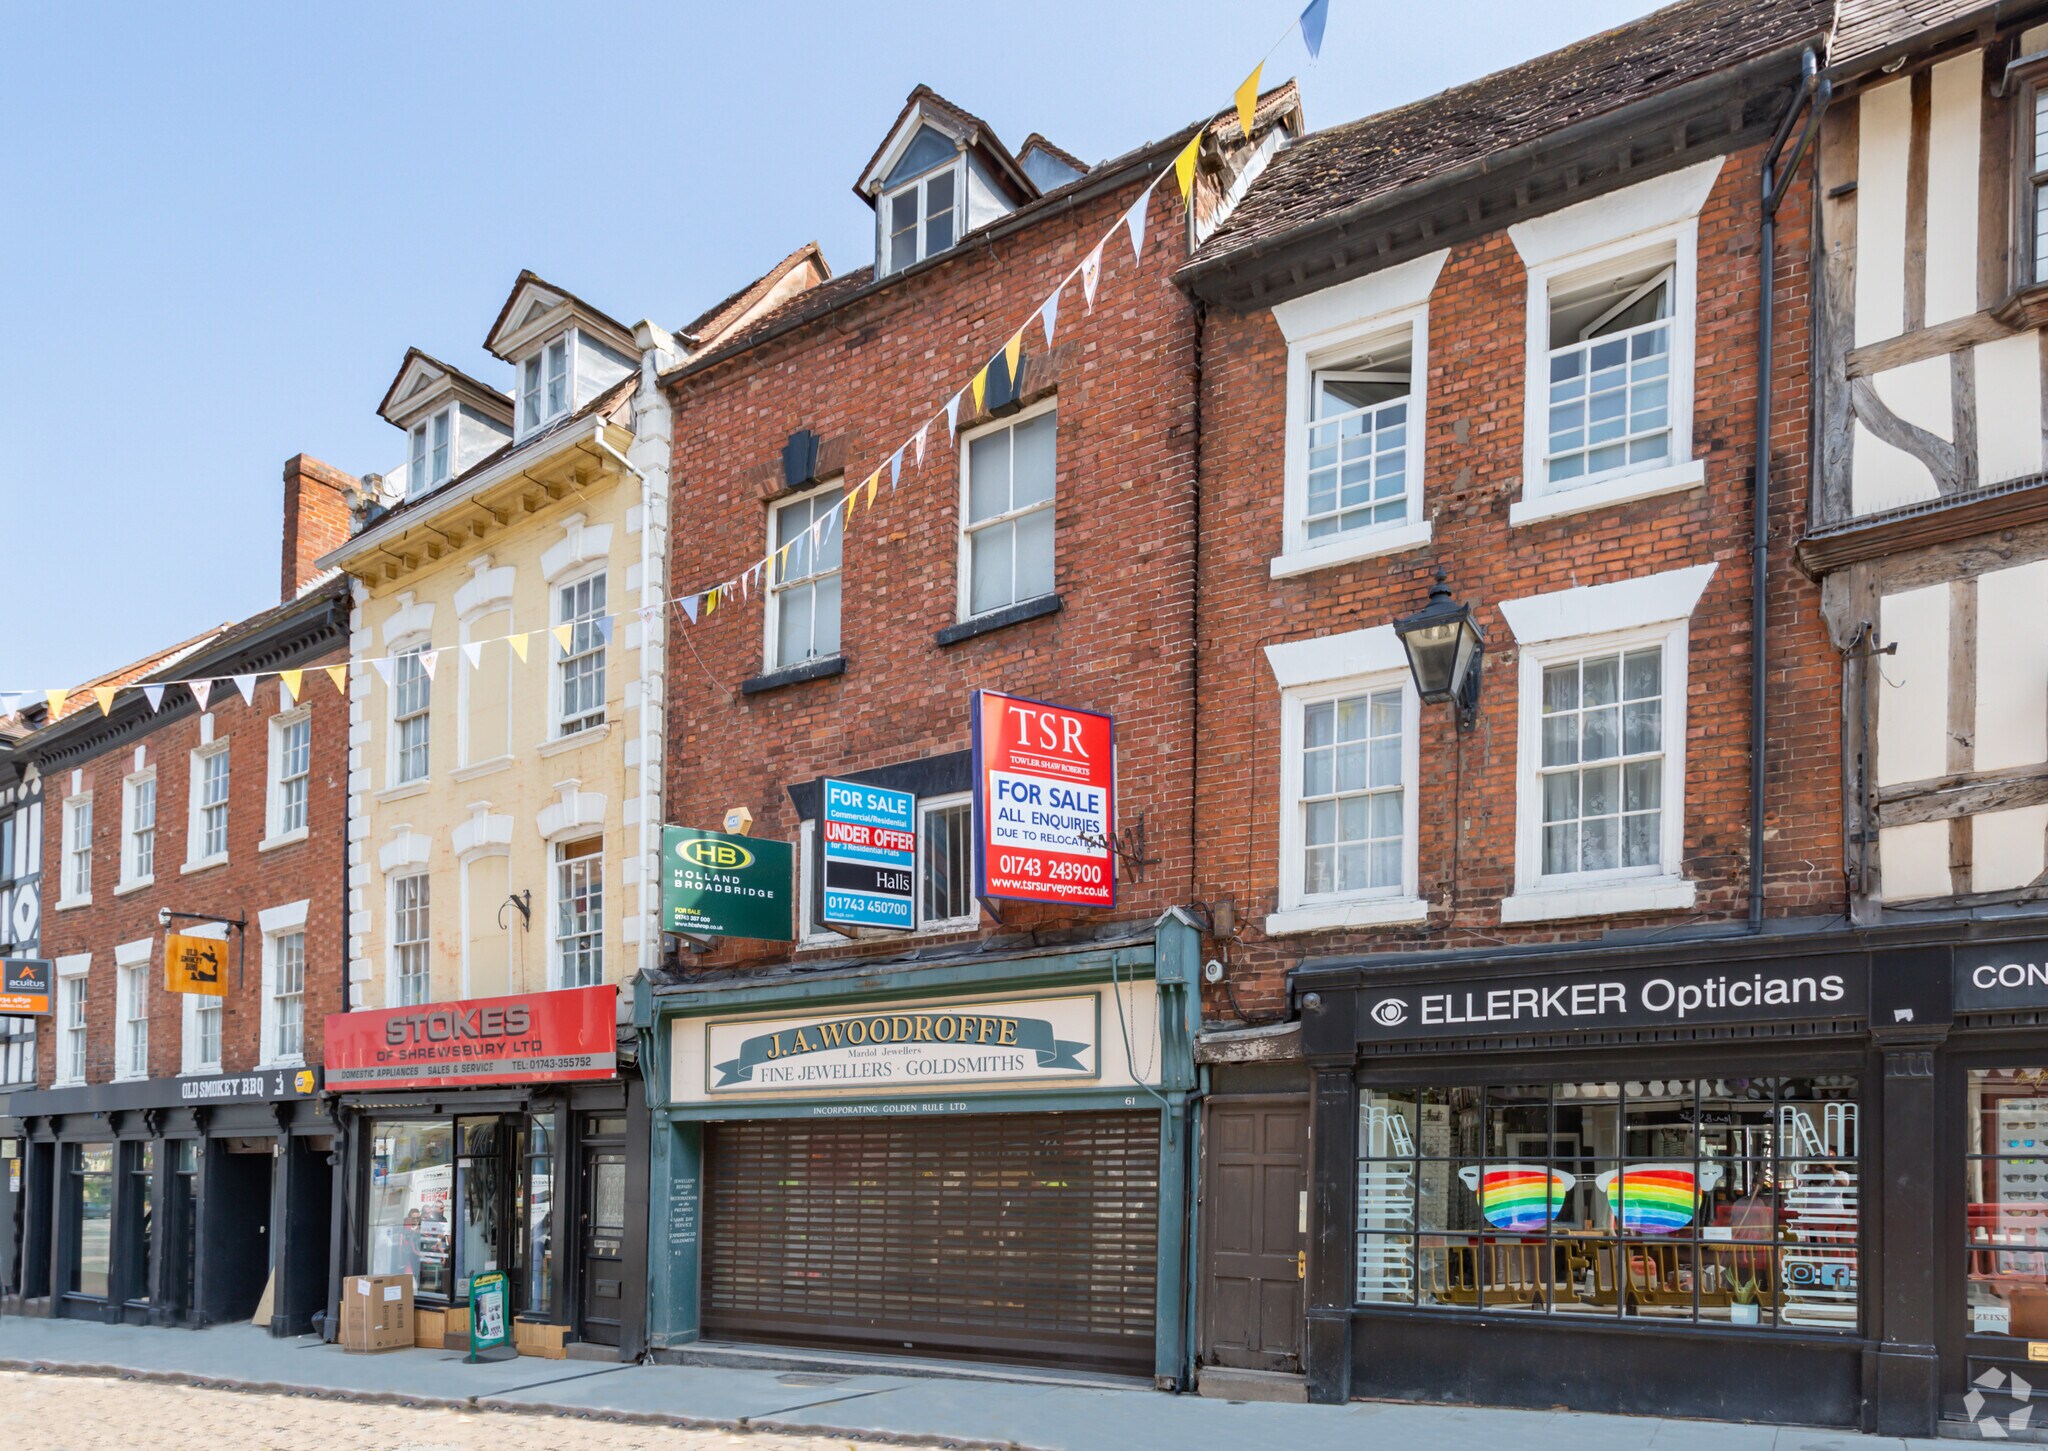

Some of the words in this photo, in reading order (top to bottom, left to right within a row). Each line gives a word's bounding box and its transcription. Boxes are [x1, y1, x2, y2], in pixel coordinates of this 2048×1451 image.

[1008, 706, 1090, 758] TSR
[1010, 756, 1040, 767] TOWLER
[1041, 760, 1060, 770] SHAW
[1061, 764, 1090, 776] ROBERTS
[830, 787, 863, 808] FOR
[867, 794, 907, 815] SALE
[998, 779, 1042, 805] FOR
[1049, 787, 1099, 814] SALE
[830, 809, 907, 827] Commercial/Residential
[998, 807, 1026, 823] ALL
[1031, 811, 1100, 833] ENQUIRIES
[826, 822, 870, 845] UNDER
[874, 828, 914, 851] OFFER
[997, 827, 1019, 839] DUE
[1023, 831, 1037, 840] TO
[695, 844, 737, 864] HB
[848, 844, 883, 855] Residential
[884, 848, 900, 857] Flats
[674, 869, 740, 884] HOLLAND
[1000, 855, 1041, 876] 01743
[1048, 860, 1102, 883] 243900
[674, 880, 774, 898] BROADBRIDGE
[876, 871, 910, 891] Halls
[991, 878, 1109, 897] www.tsrsurveyors.co.uk
[828, 896, 865, 911] 01743
[867, 900, 908, 916] 450700
[186, 948, 198, 956] OLD
[9, 979, 45, 987] acuitus
[1421, 982, 1627, 1025] ELLERKER
[1641, 973, 1845, 1018] Opticians
[386, 1003, 531, 1046] STOKES
[818, 1015, 1019, 1048] WOODROFFE
[376, 1050, 394, 1062] OF
[399, 1042, 506, 1060] SHREWSBURY
[513, 1040, 543, 1052] LTD
[848, 1048, 877, 1058] Mardol
[881, 1046, 922, 1056] Jewellers
[341, 1069, 374, 1080] DOMESTIC
[377, 1067, 419, 1077] APPLIANCES
[427, 1065, 450, 1075] SALES
[453, 1065, 458, 1074] &
[461, 1062, 494, 1073] SERVICE
[529, 1057, 591, 1069] 01743-355752
[761, 1067, 794, 1082] FINE
[797, 1061, 892, 1081] JEWELLERS
[905, 1054, 1024, 1076] GOLDSMITHS
[182, 1082, 198, 1099] OLD
[199, 1079, 240, 1098] SMOKEY
[241, 1077, 264, 1098] BBQ
[813, 1105, 878, 1115] INCORPORATING
[882, 1103, 918, 1113] GOLDEN
[922, 1102, 945, 1112] RULE
[1975, 1313, 2008, 1321] ZEISS
